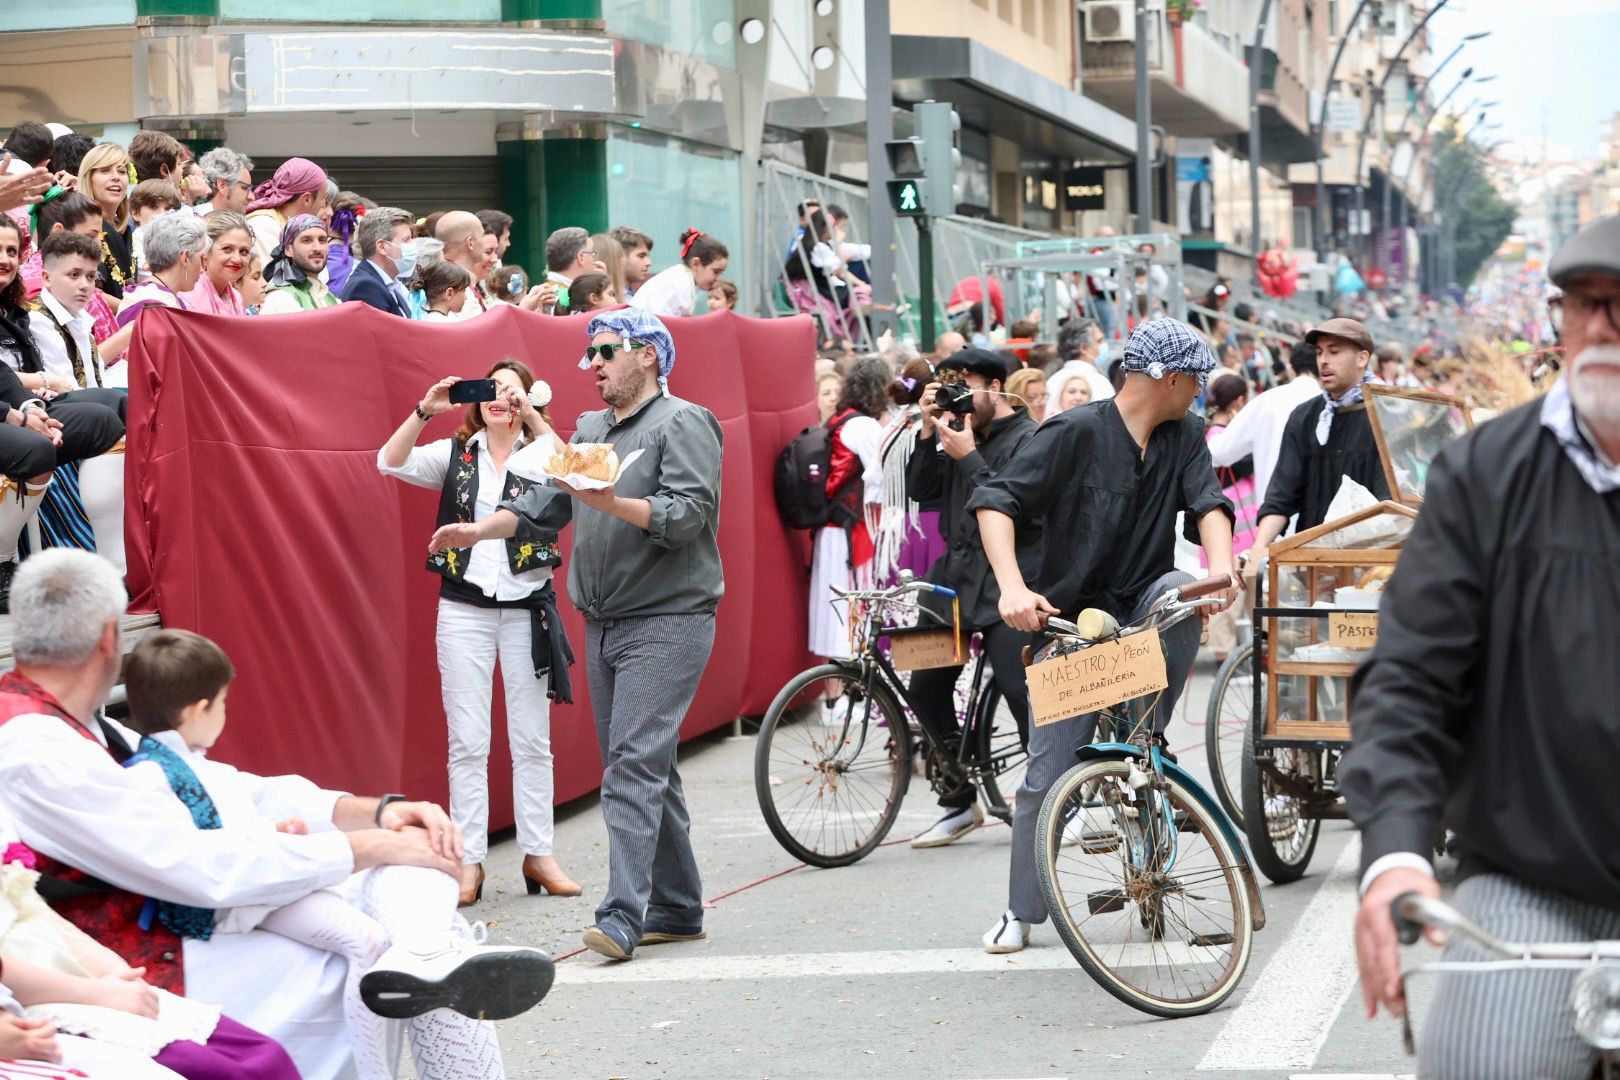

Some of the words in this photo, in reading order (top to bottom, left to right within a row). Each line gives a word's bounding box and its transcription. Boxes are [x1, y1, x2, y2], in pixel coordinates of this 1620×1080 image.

[1337, 624, 1377, 638] PASTE
[1041, 654, 1106, 689] MAESTRO
[1059, 690, 1073, 701] DE
